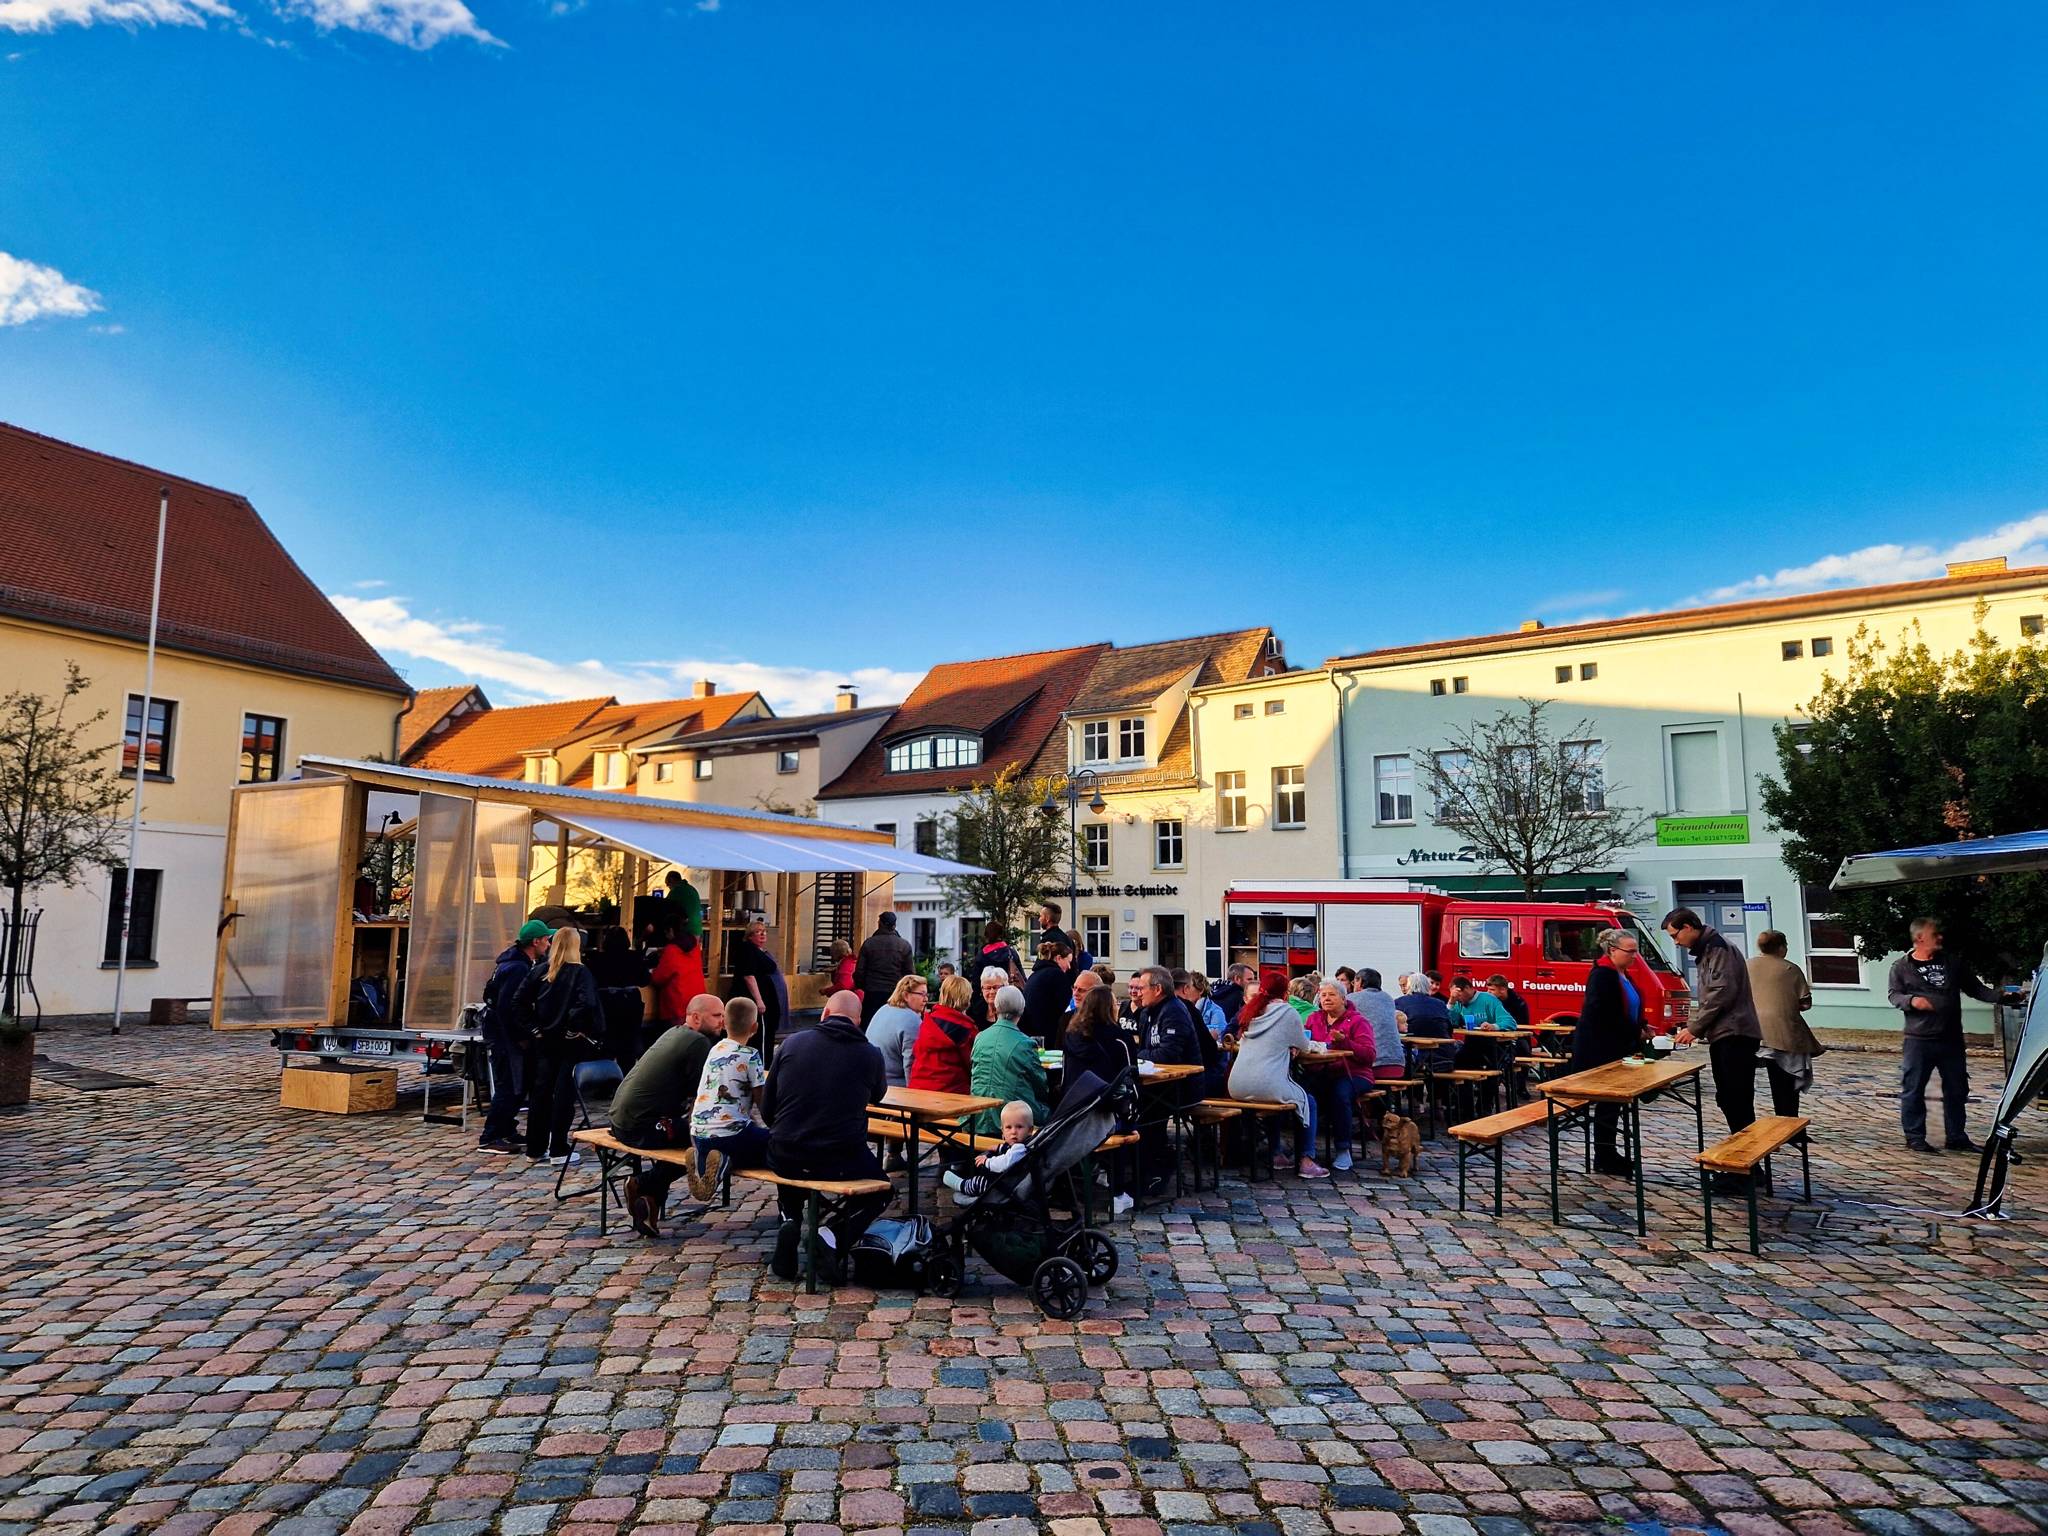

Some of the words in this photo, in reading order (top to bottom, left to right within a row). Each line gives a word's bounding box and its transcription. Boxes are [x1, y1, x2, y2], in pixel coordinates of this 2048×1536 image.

[1662, 822, 1744, 833] Ferienwohnung
[1097, 885, 1120, 897] Alte
[1124, 884, 1178, 898] Schmiede
[1522, 980, 1587, 992] Feuerwehr
